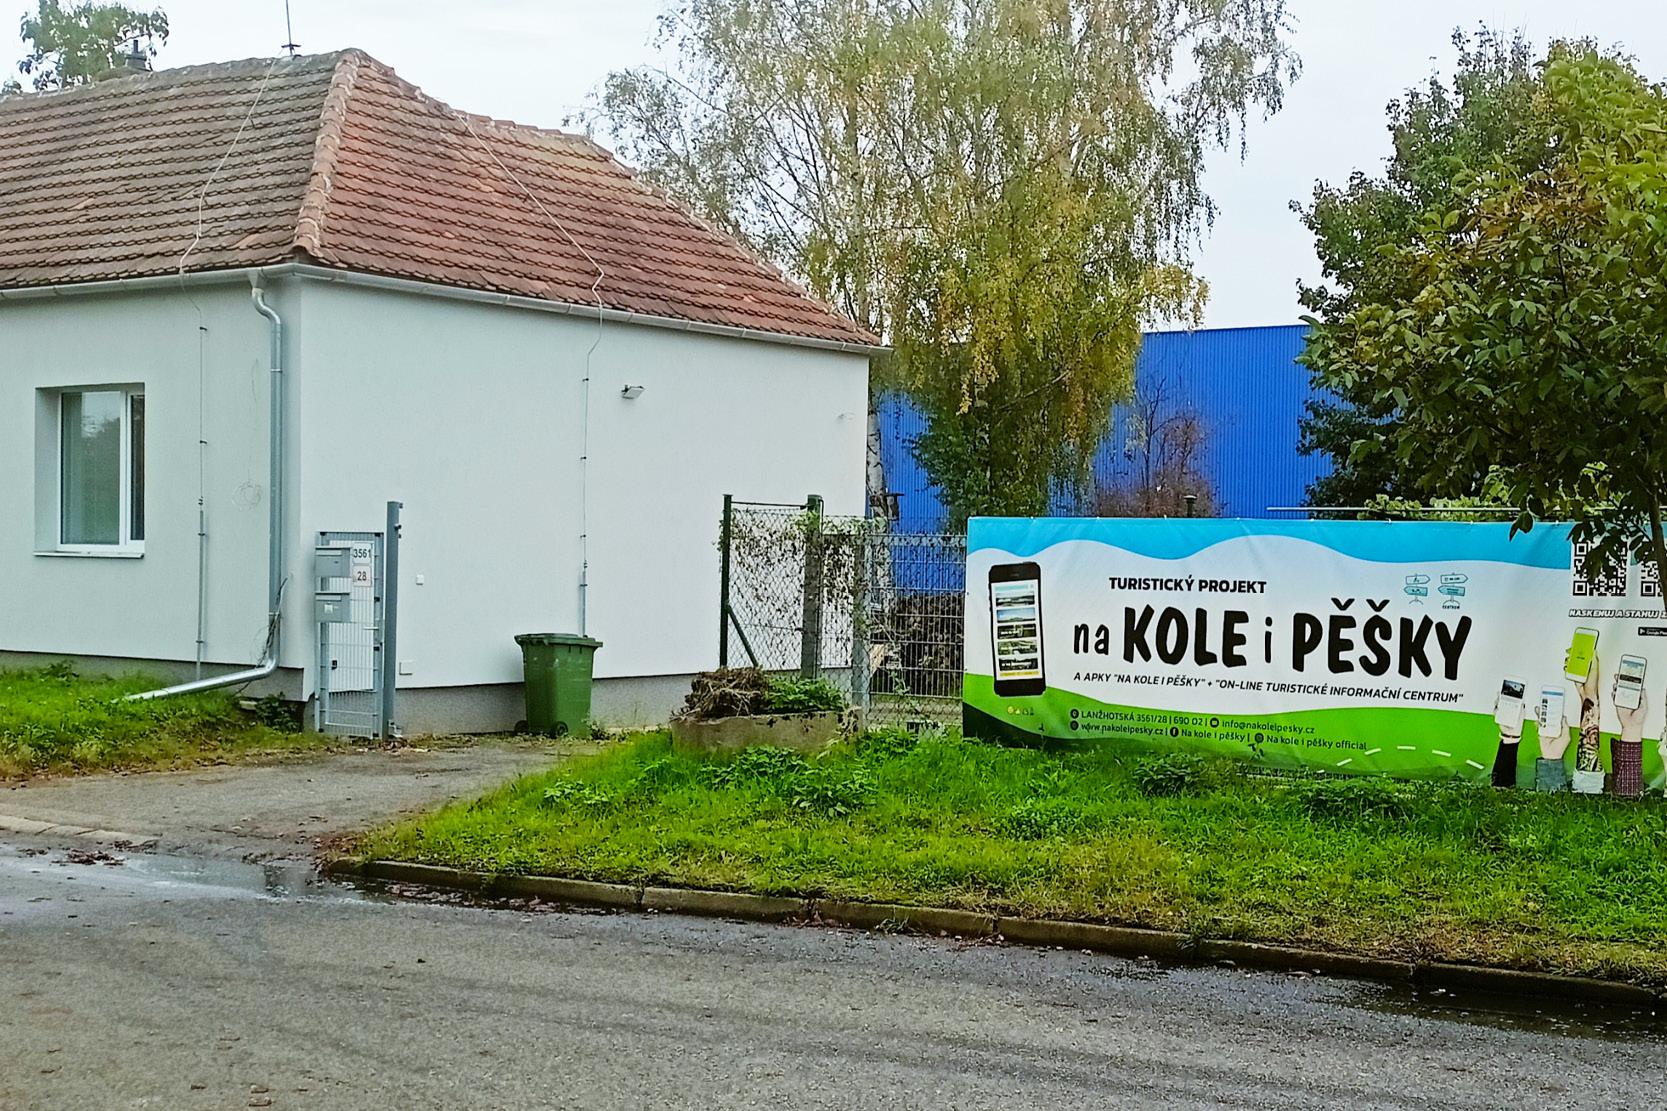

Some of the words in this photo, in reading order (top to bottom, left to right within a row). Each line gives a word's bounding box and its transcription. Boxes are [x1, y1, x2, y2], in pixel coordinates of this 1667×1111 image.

[353, 548, 371, 558] 3561
[357, 571, 367, 581] 28
[1109, 574, 1194, 592] TURISTICKÝ
[1198, 579, 1267, 593] PROJEKT
[1074, 623, 1109, 656] na
[1123, 604, 1249, 668] KOLE
[1264, 616, 1273, 664] i
[1292, 597, 1472, 680] PĚŠKY
[1073, 672, 1081, 681] A
[1083, 672, 1111, 682] APKY
[1133, 675, 1159, 685] KOLE
[1166, 675, 1206, 687] PĚŠKY"
[1215, 679, 1263, 691] "ON-LINE
[1266, 682, 1328, 695] TURISTICKÉ
[1329, 686, 1402, 700] INFORMAČNÍ
[1403, 691, 1464, 703] CENTRUM"
[1081, 709, 1135, 721] LANŽHOTSKÁ
[1137, 713, 1167, 724] 3561/28
[1174, 716, 1190, 725] 690
[1222, 720, 1315, 734] info@nakoleipesky.cz
[1181, 728, 1192, 737] Na
[1194, 730, 1212, 739] kole
[1219, 731, 1245, 742] pěšky
[1266, 735, 1278, 744] Na
[1280, 736, 1299, 745] kole
[1306, 738, 1333, 750] pěšky
[1335, 740, 1367, 750] official
